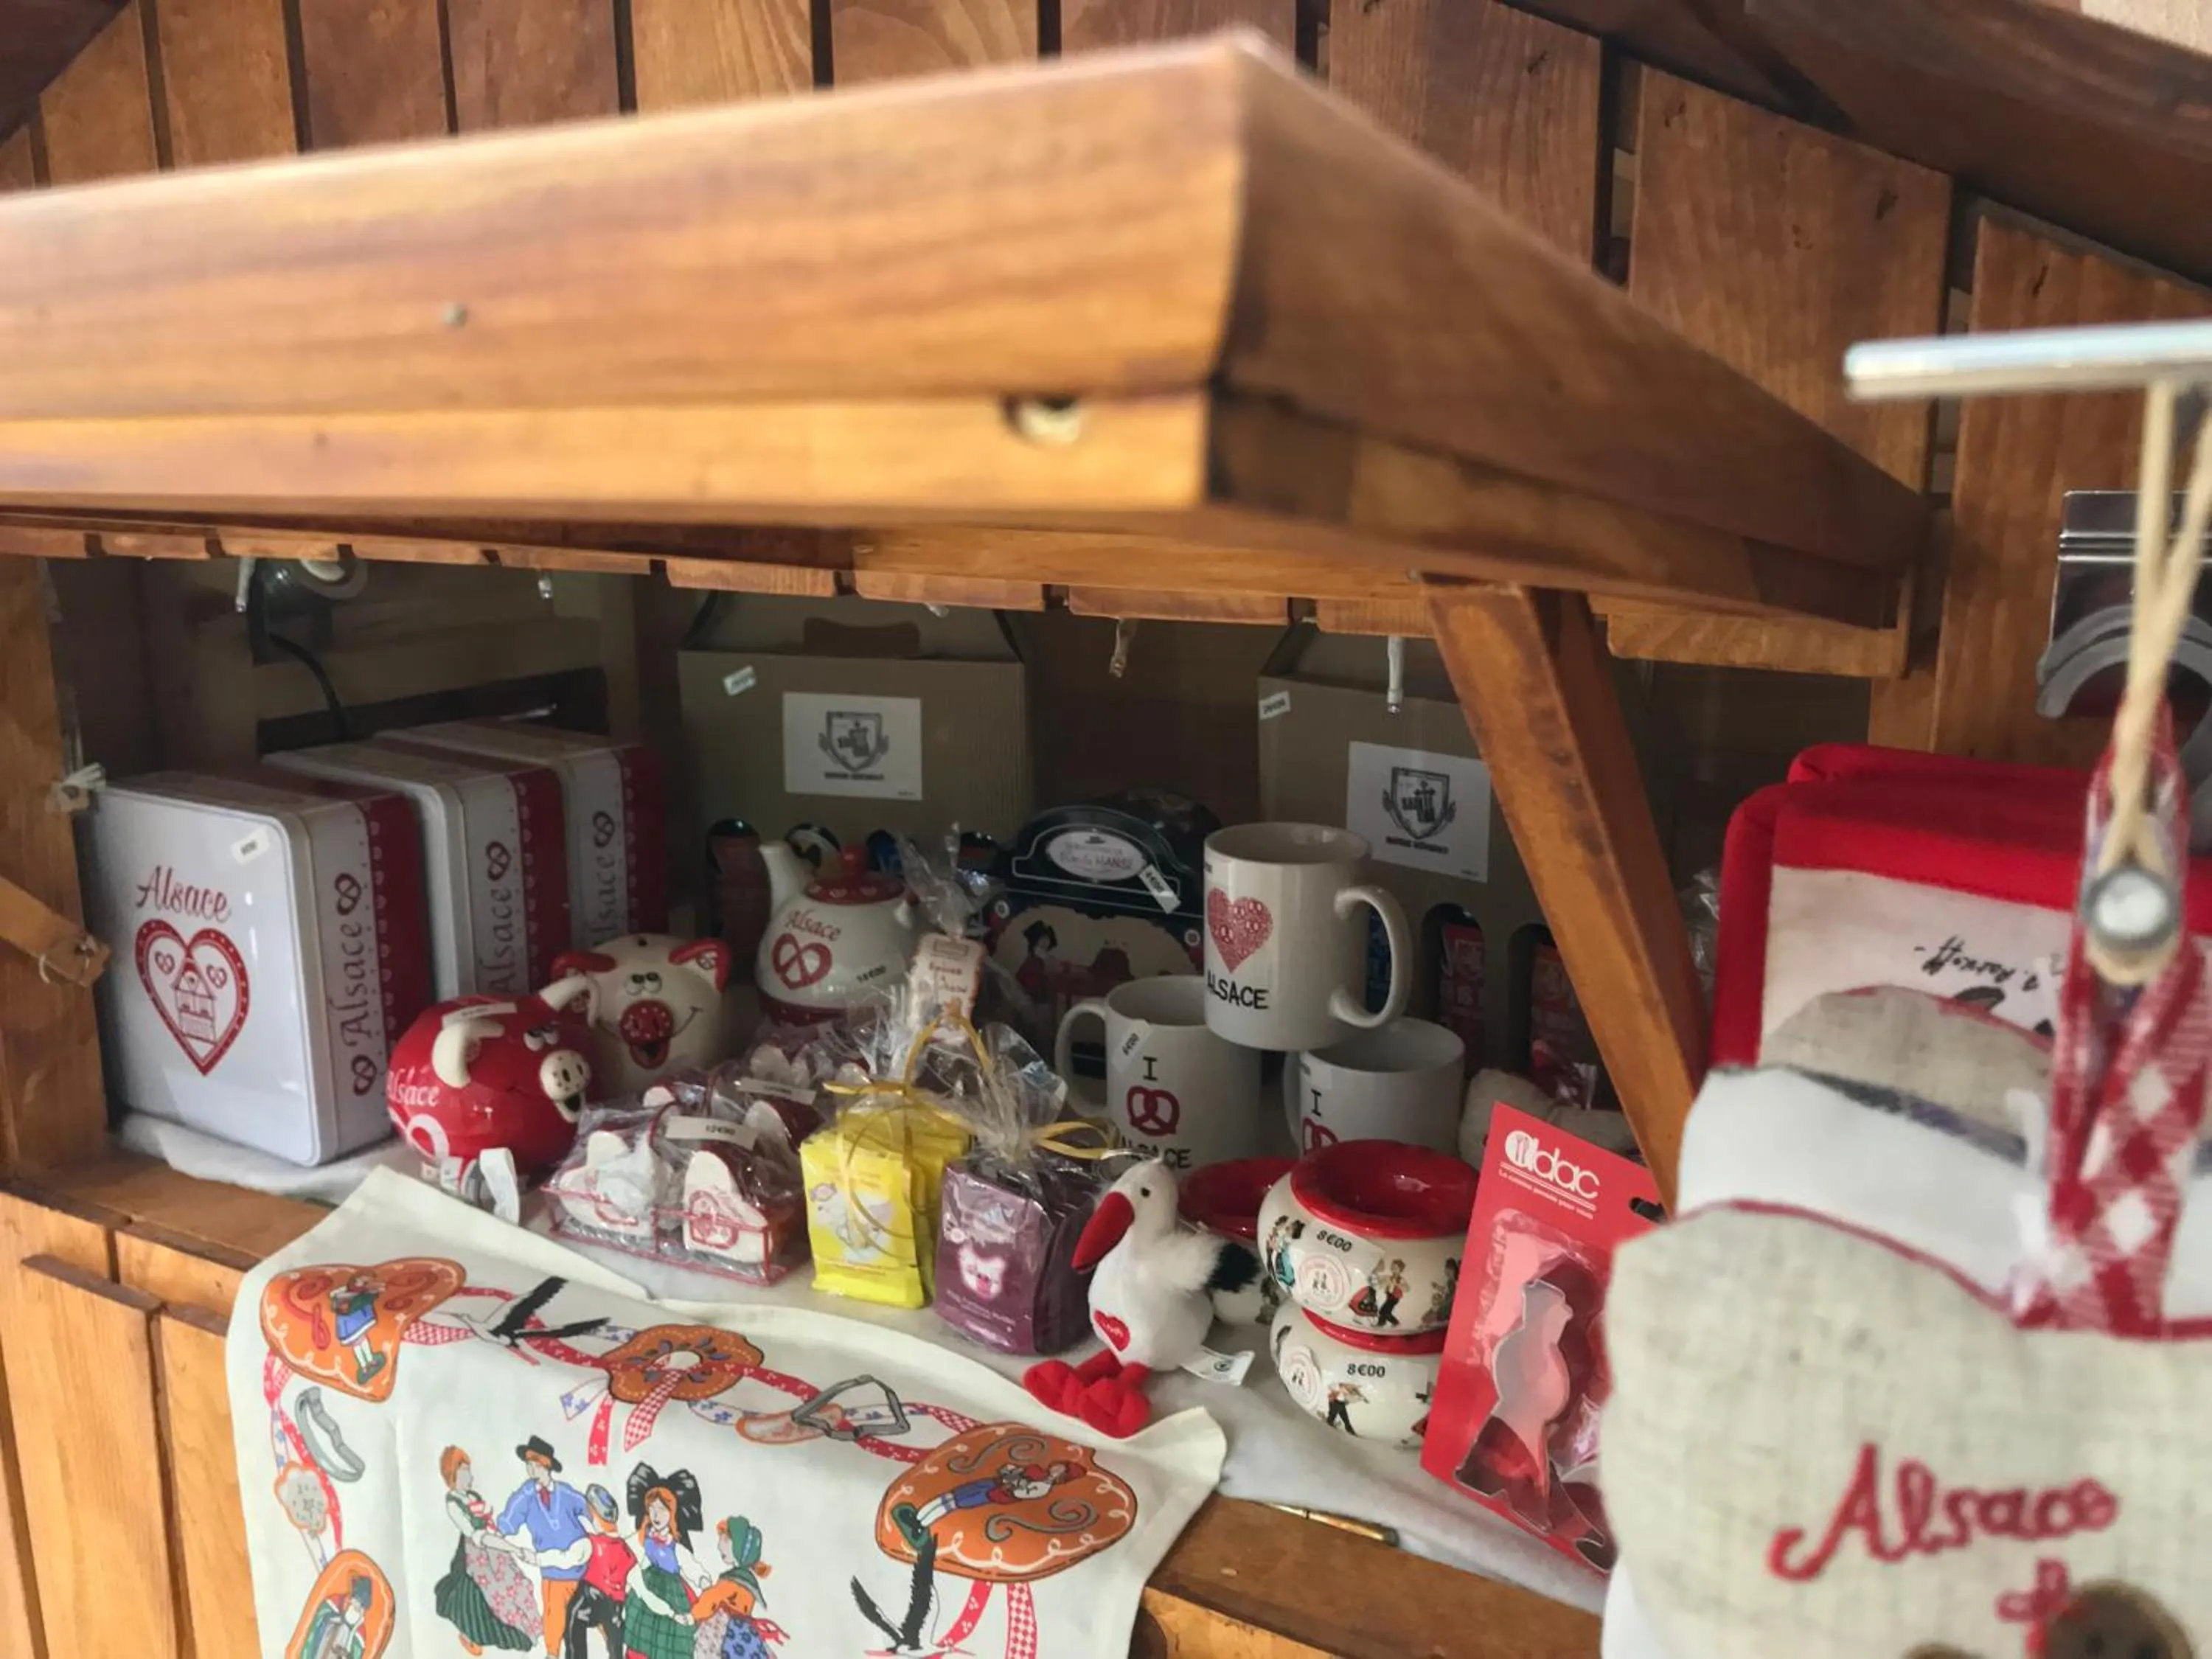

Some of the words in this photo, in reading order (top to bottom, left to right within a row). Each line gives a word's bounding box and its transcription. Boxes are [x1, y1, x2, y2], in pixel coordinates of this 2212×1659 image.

[136, 865, 232, 923] Alsace
[588, 854, 619, 947] lsace
[479, 887, 516, 992] Alsace
[785, 908, 841, 942] Alsace
[330, 922, 372, 1048] Alsace
[1143, 1056, 1158, 1081] I
[1310, 1088, 1322, 1116] I
[1317, 1230, 1353, 1252] 8€00
[1348, 1363, 1385, 1378] 8€00
[1768, 1441, 2119, 1583] Alsace
